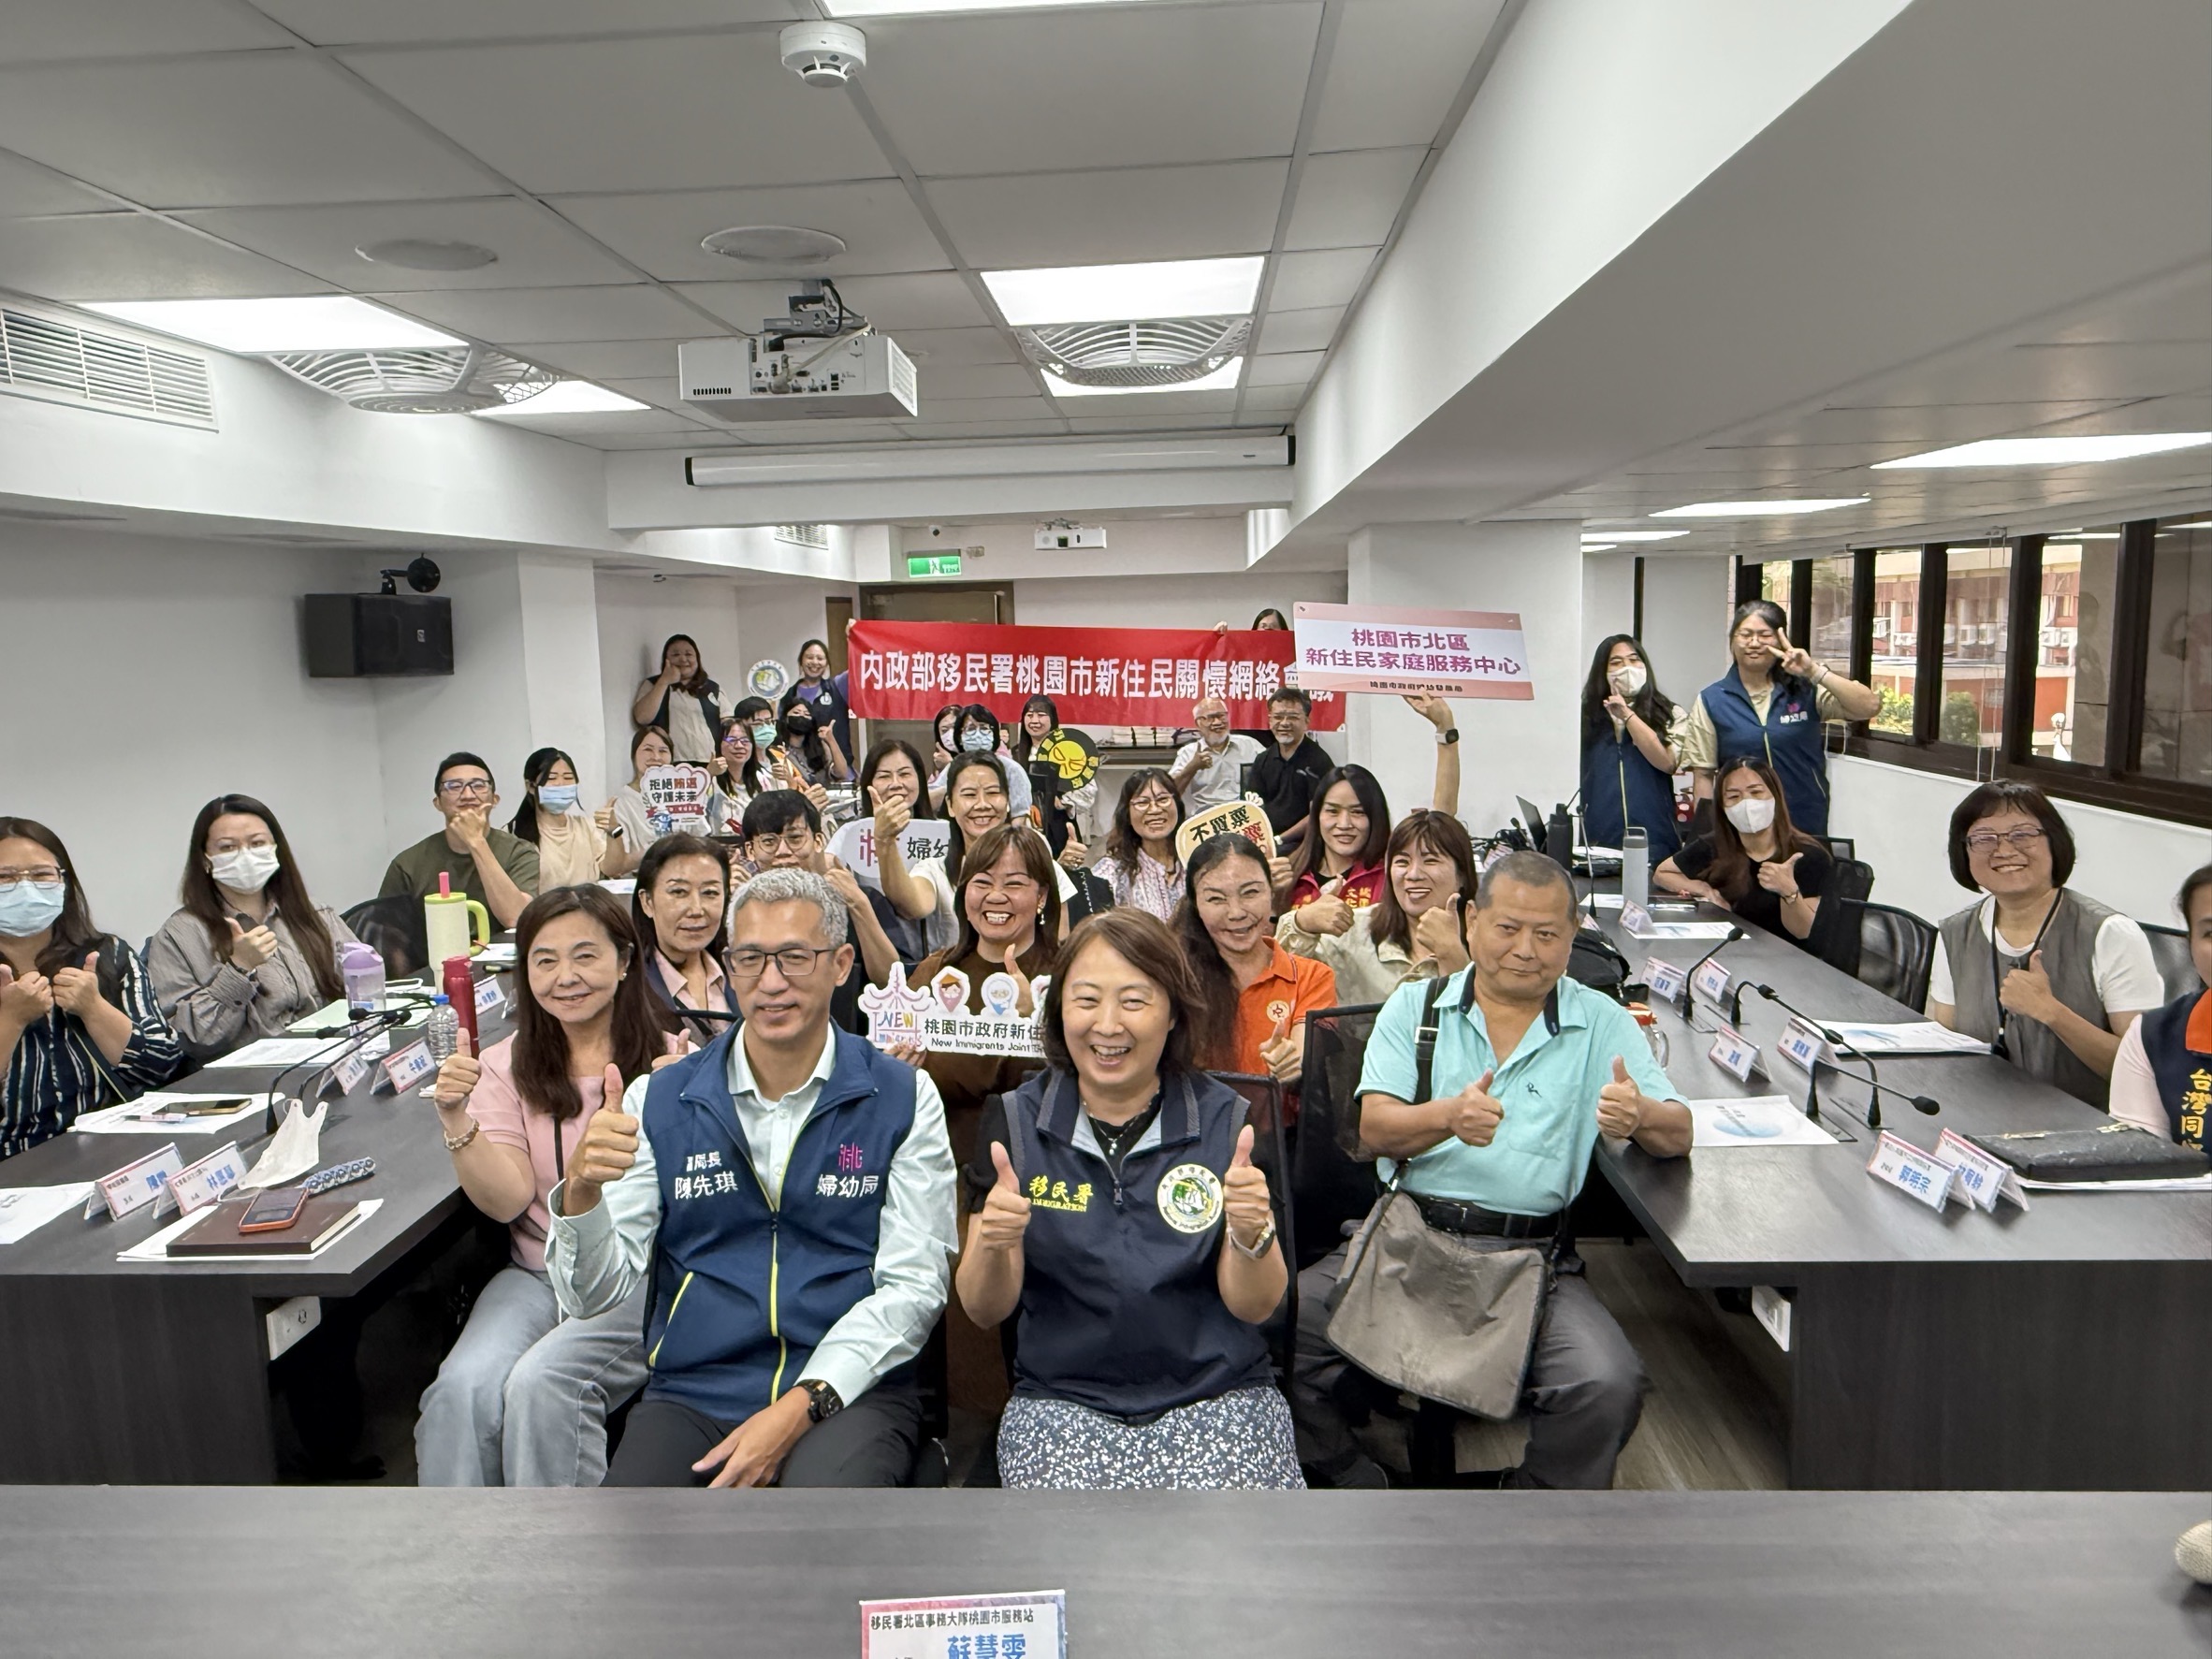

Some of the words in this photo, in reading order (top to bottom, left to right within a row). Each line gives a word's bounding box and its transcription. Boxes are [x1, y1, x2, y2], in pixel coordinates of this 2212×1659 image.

[1351, 628, 1470, 651] 桃園市北區
[1305, 648, 1521, 676] 新住民家庭服務中心
[877, 1011, 914, 1028] NEW
[675, 1171, 739, 1200] 陳先琪
[816, 1174, 880, 1198] 婦幼局
[1029, 1174, 1094, 1205] 移民署
[870, 1608, 1034, 1631] 移民署北區事務大隊桃園市服務站
